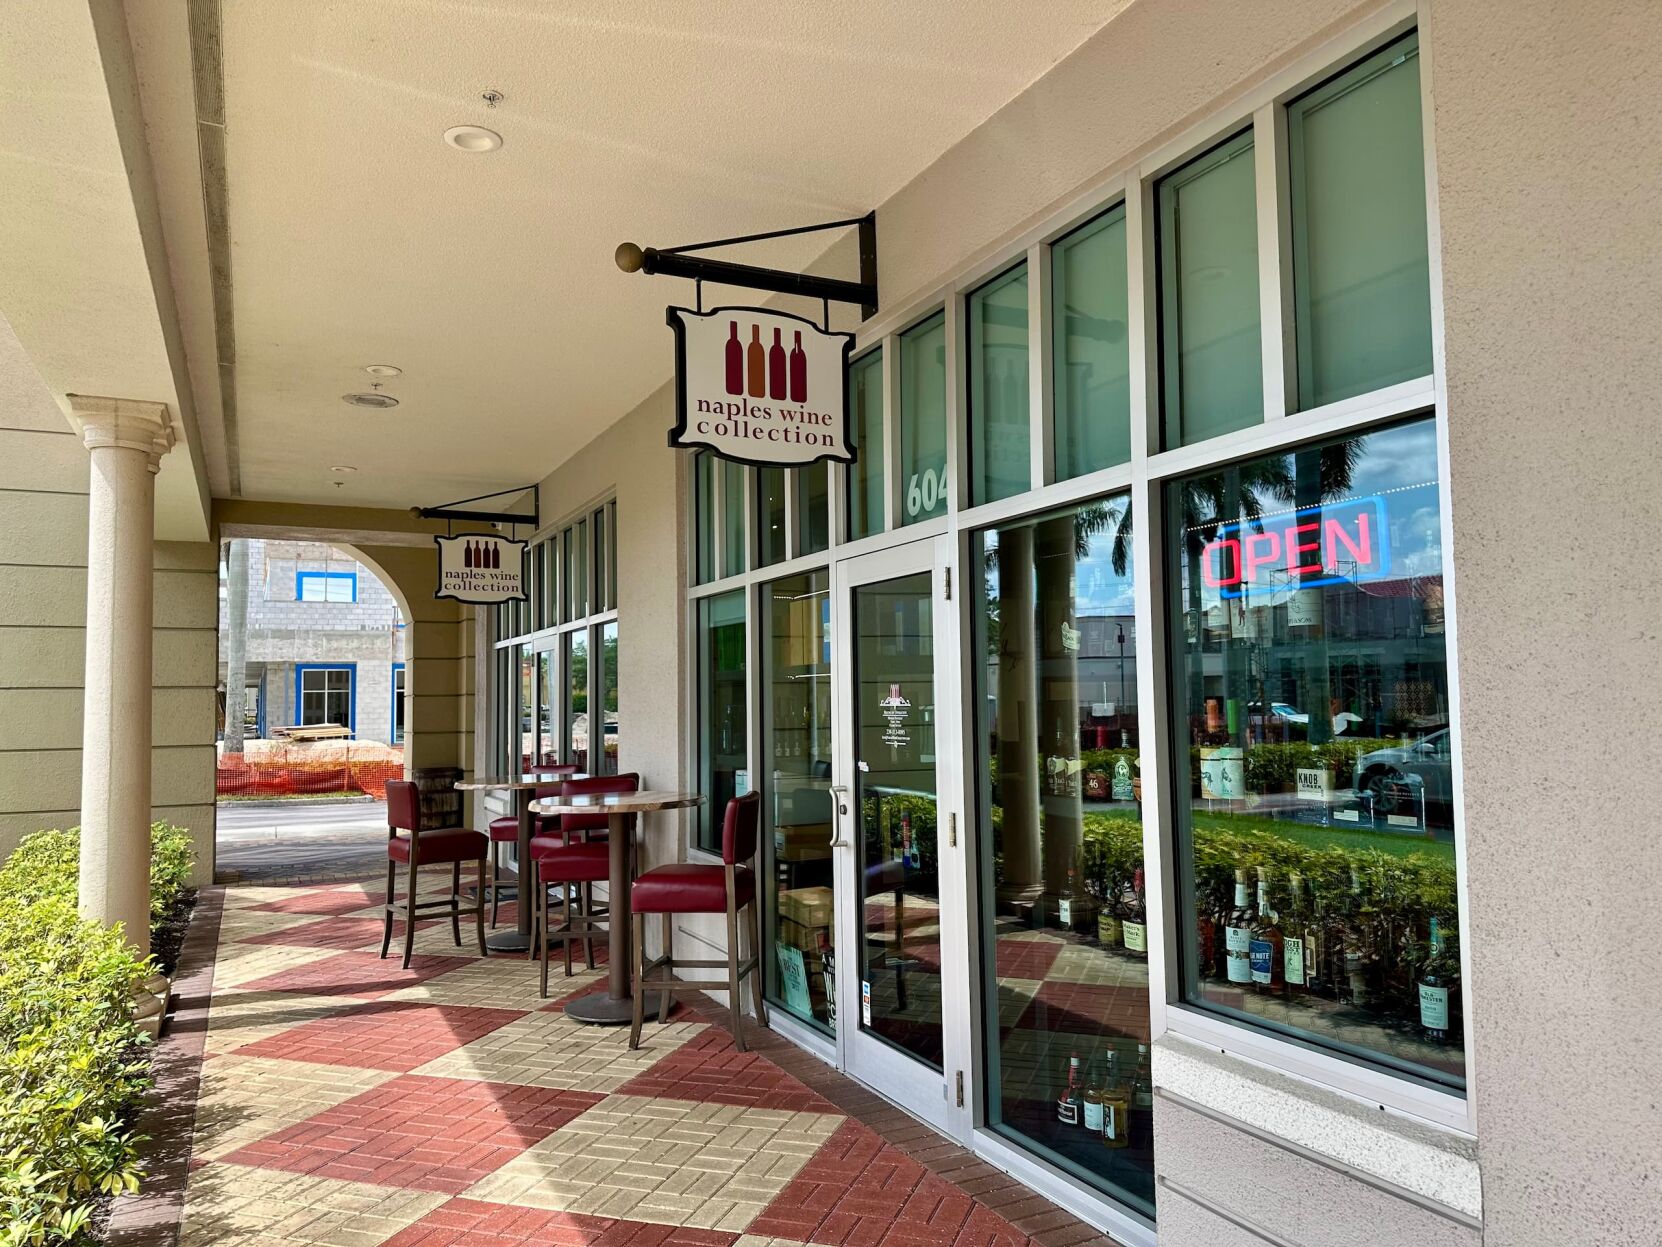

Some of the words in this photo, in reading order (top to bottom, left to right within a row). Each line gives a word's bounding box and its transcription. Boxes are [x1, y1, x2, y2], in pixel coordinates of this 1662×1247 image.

[697, 398, 772, 421] naples
[779, 405, 833, 426] wine
[697, 420, 835, 447] collection
[1202, 513, 1372, 588] OPEN
[445, 569, 486, 582] naples
[490, 571, 519, 581] wine
[444, 581, 519, 593] collection
[1089, 779, 1099, 789] 46
[1298, 773, 1318, 785] KNOB
